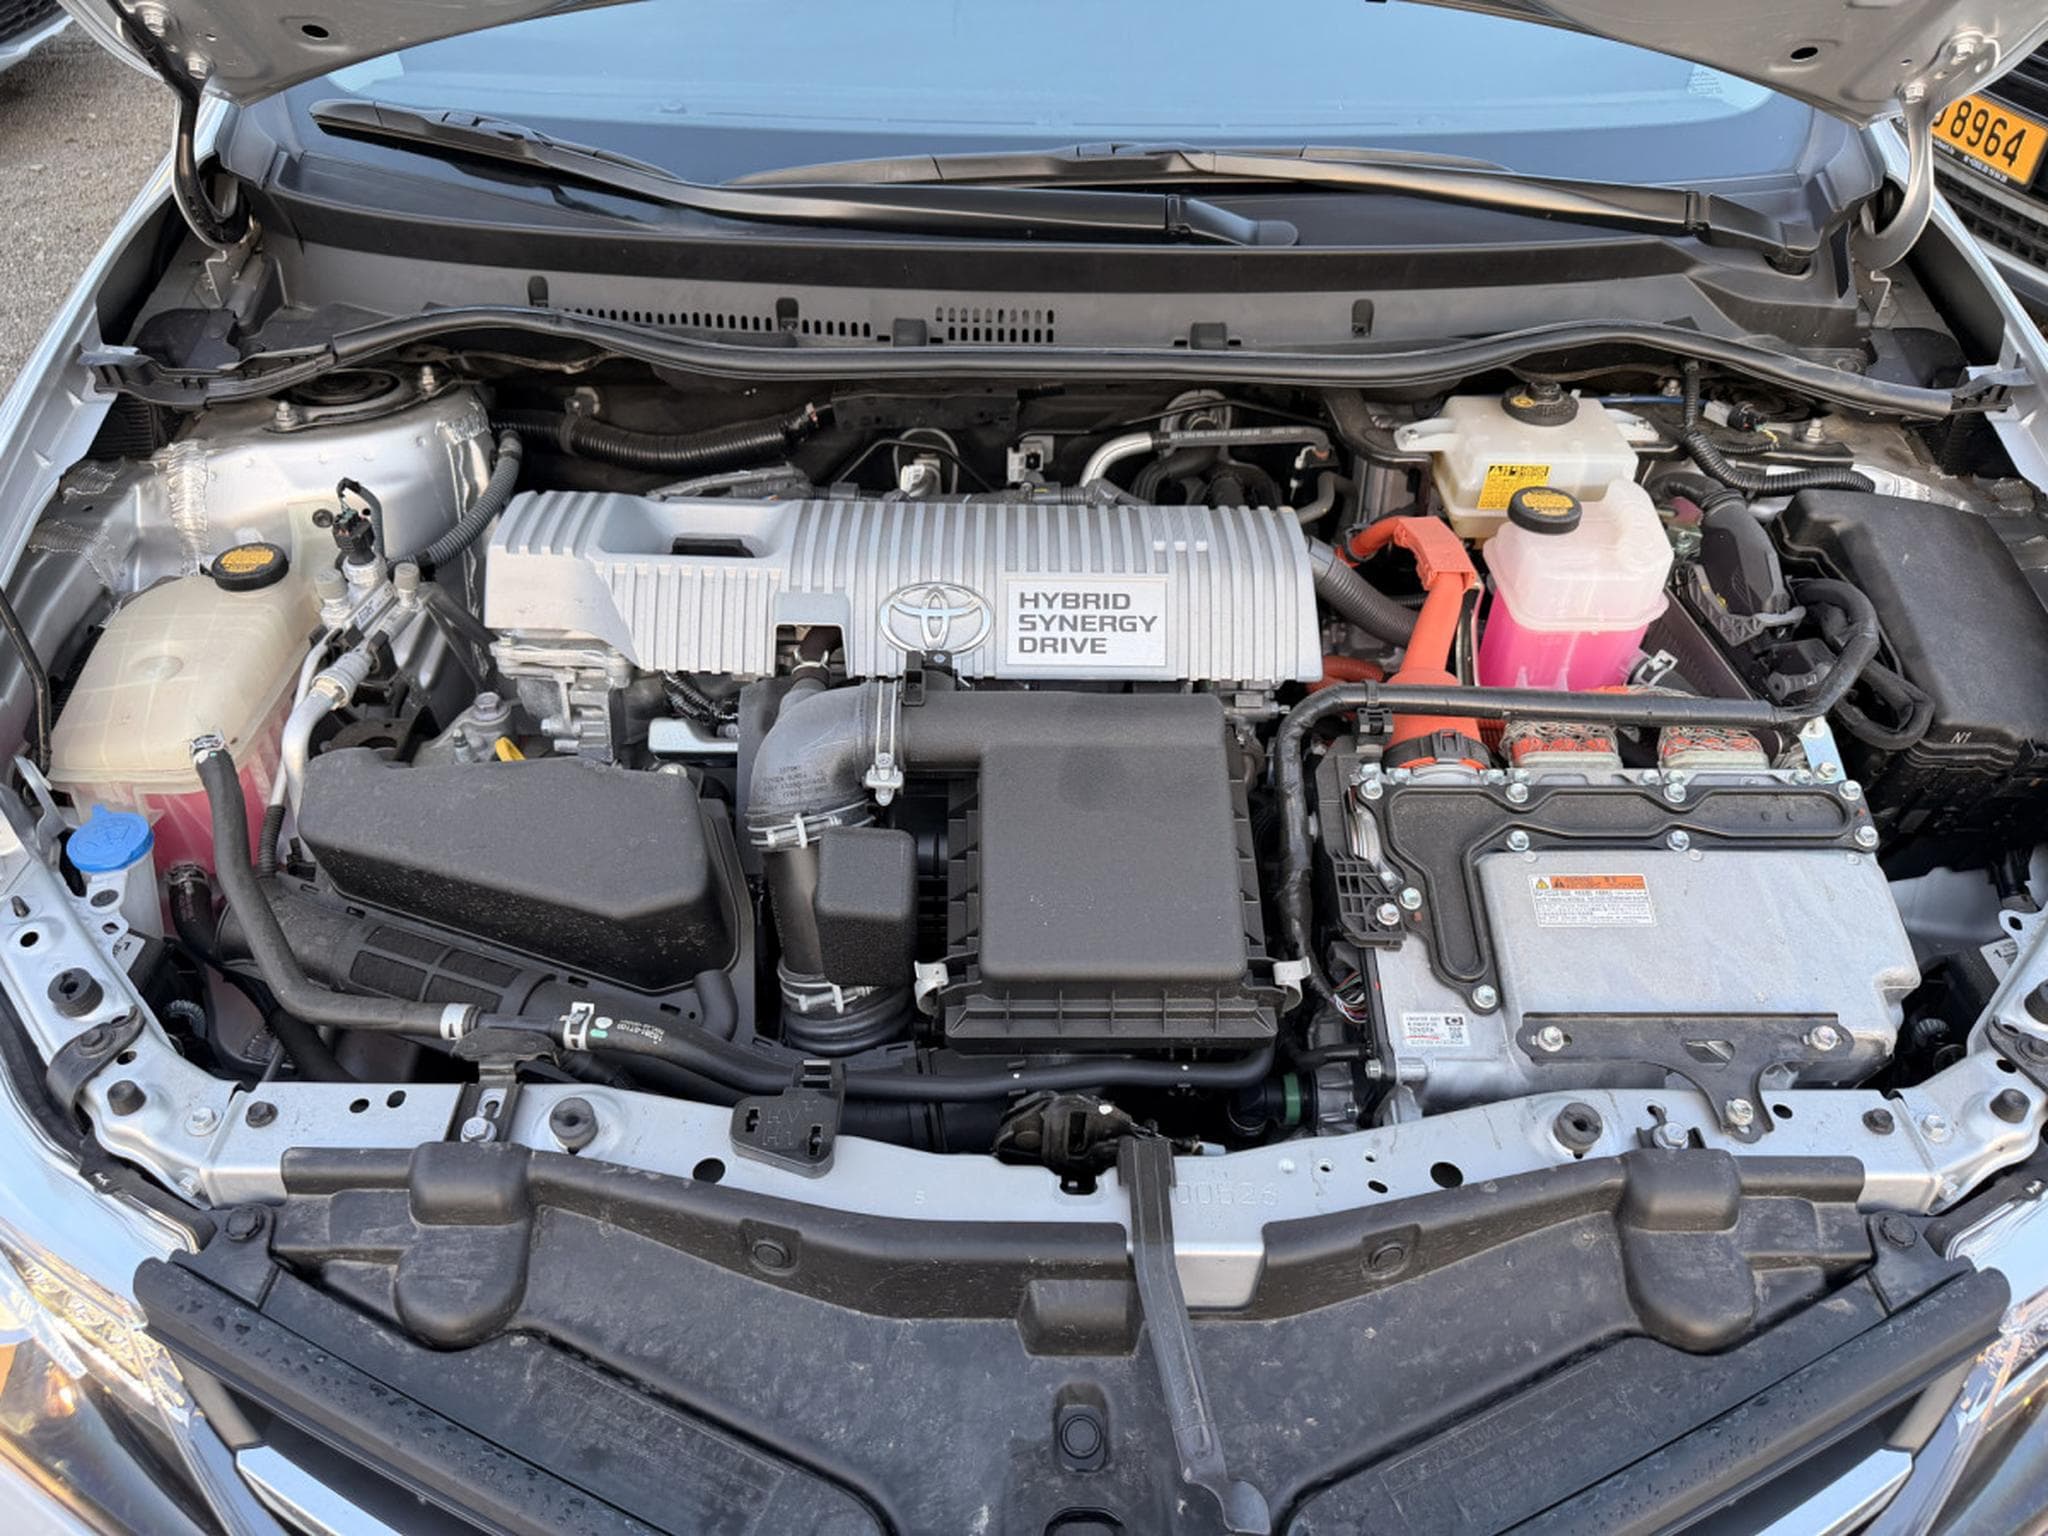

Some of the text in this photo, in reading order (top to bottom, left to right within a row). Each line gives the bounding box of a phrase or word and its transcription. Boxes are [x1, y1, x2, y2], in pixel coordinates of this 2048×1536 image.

[1018, 592, 1131, 610] HYBRID
[1018, 614, 1158, 632] SYNERGY
[1018, 637, 1108, 654] DRIVE
